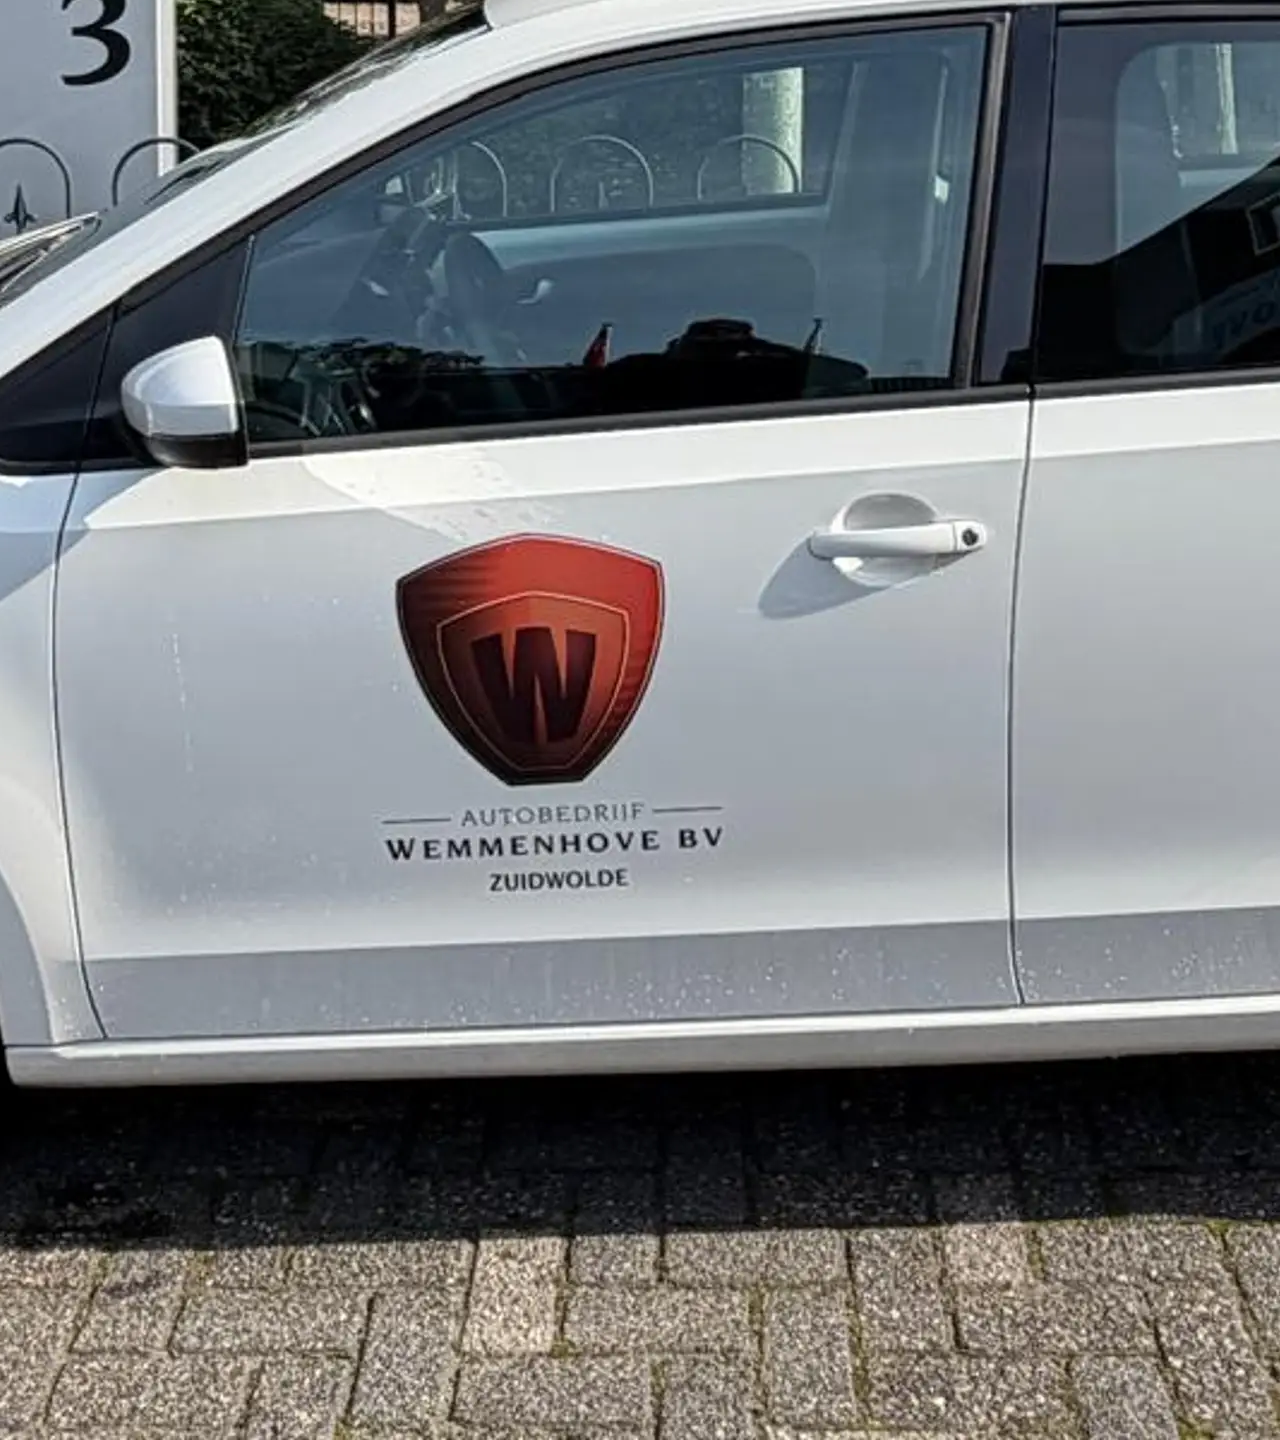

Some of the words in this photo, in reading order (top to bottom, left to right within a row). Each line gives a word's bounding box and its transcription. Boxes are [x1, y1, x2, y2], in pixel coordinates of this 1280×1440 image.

[470, 625, 598, 744] W
[384, 828, 660, 861] WEMMENHOVE
[677, 826, 724, 850] BV
[488, 867, 630, 893] ZUIDWOLDE
